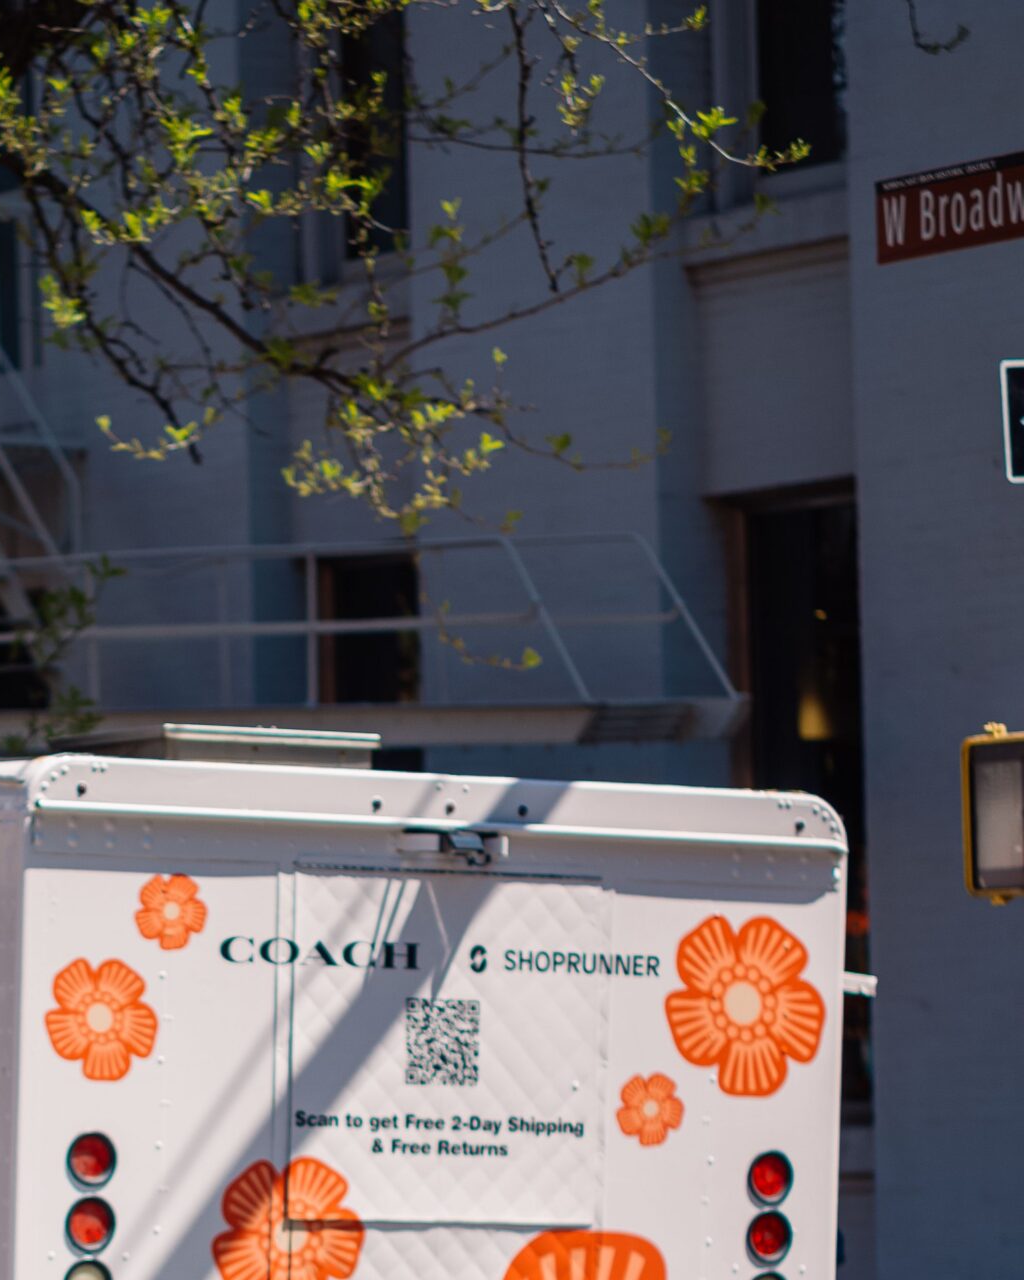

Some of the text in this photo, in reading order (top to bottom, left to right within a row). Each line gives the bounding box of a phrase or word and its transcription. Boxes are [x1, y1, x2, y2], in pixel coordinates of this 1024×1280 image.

[882, 194, 907, 247] W
[219, 935, 420, 970] COACH
[504, 949, 660, 977] SHOPRUNNER
[295, 1110, 584, 1137] Scan to get Free 2-Day Shipping
[371, 1139, 509, 1157] & Free Returns
